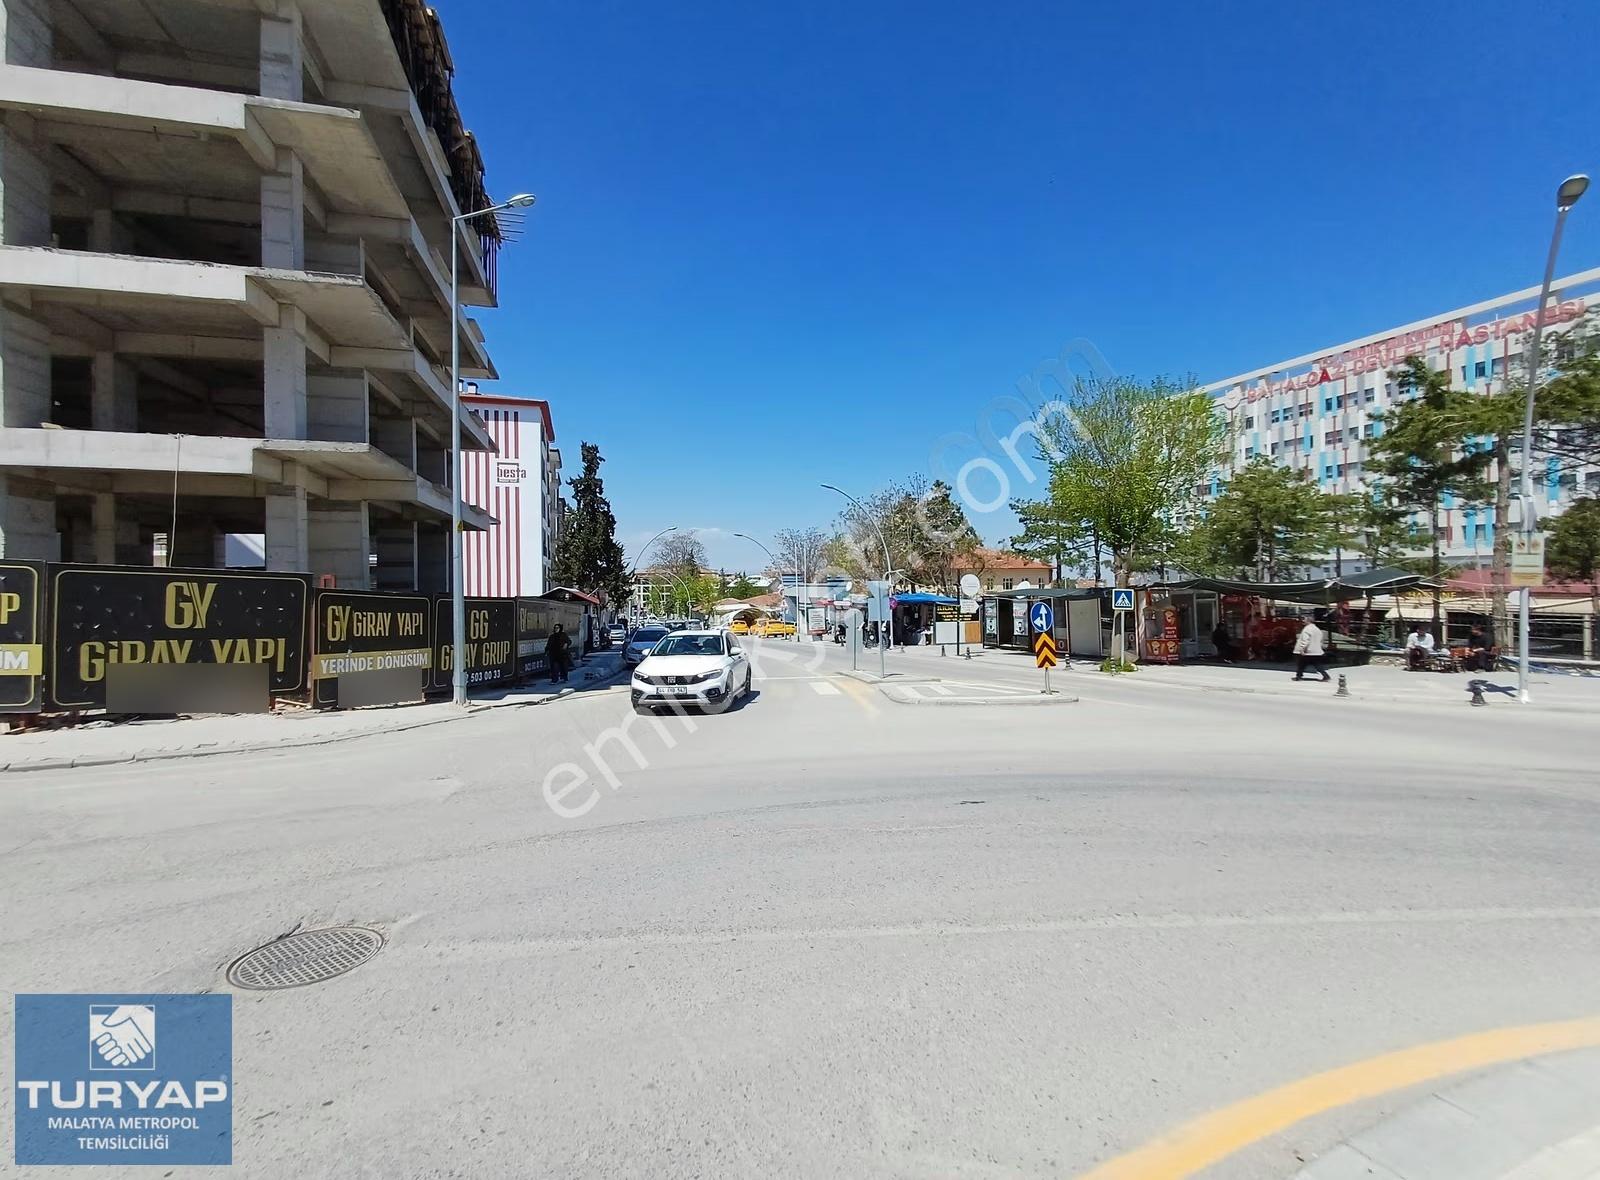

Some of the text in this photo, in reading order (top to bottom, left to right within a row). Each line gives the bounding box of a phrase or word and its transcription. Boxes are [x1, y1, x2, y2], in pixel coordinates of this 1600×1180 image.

[497, 466, 527, 479] besta
[165, 581, 218, 629] GY
[327, 605, 351, 641] GY
[397, 611, 423, 636] YAPI
[470, 609, 489, 640] GG
[211, 638, 286, 673] YAPI
[321, 654, 374, 674] YERİNDE
[482, 640, 510, 666] GRUP
